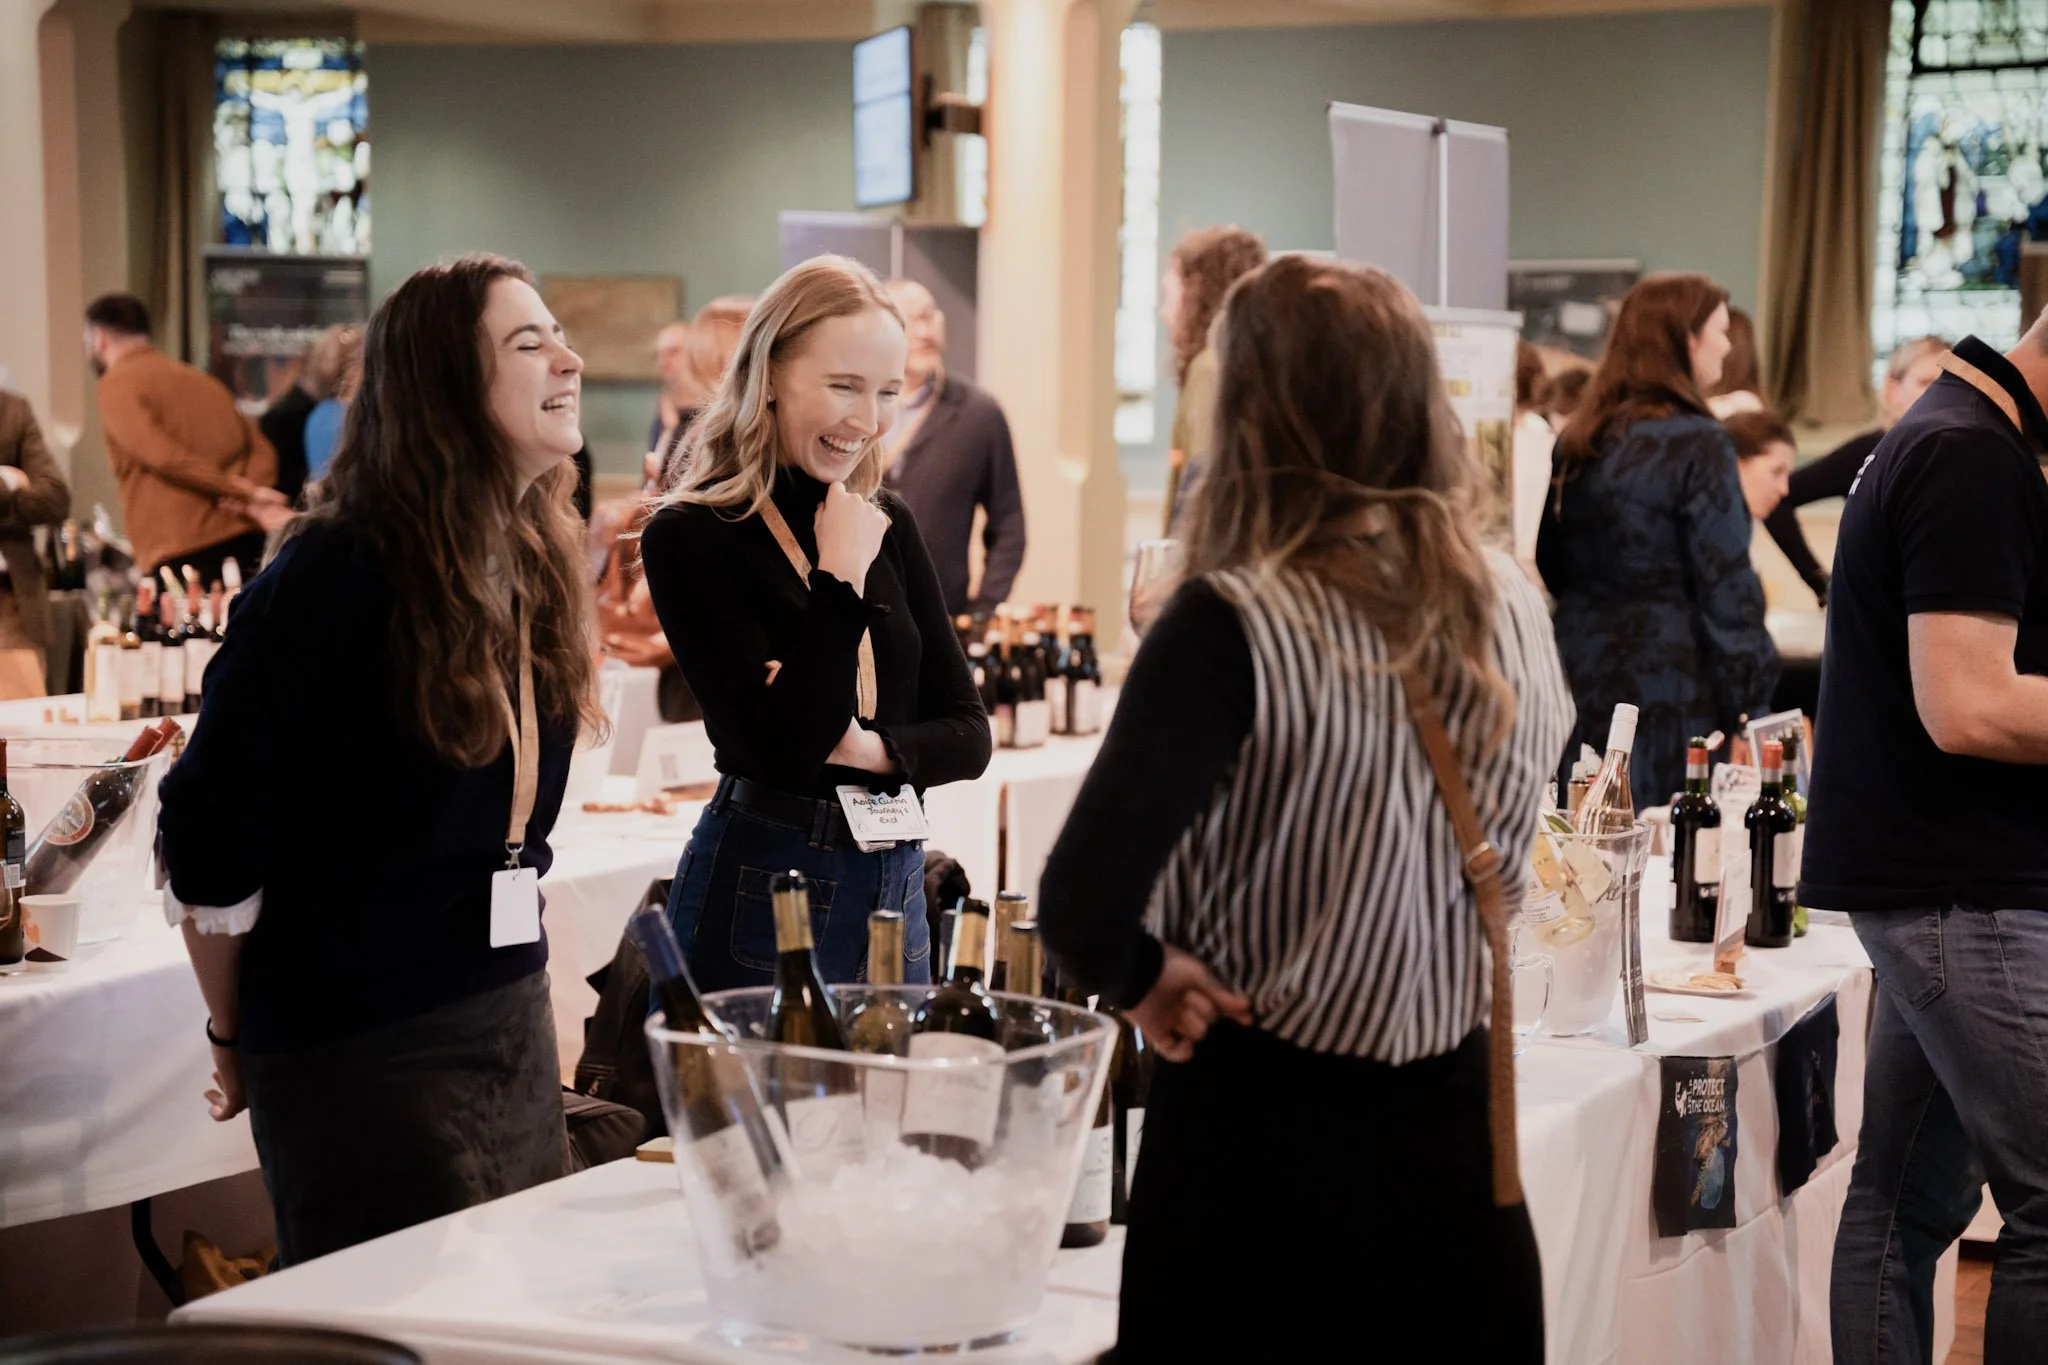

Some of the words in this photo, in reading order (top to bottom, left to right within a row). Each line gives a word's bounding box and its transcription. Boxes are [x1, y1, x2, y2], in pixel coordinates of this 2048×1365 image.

[1692, 1078, 1725, 1096] PROTECT
[1691, 1099, 1703, 1113] THE
[1702, 1099, 1726, 1113] OCEAN
